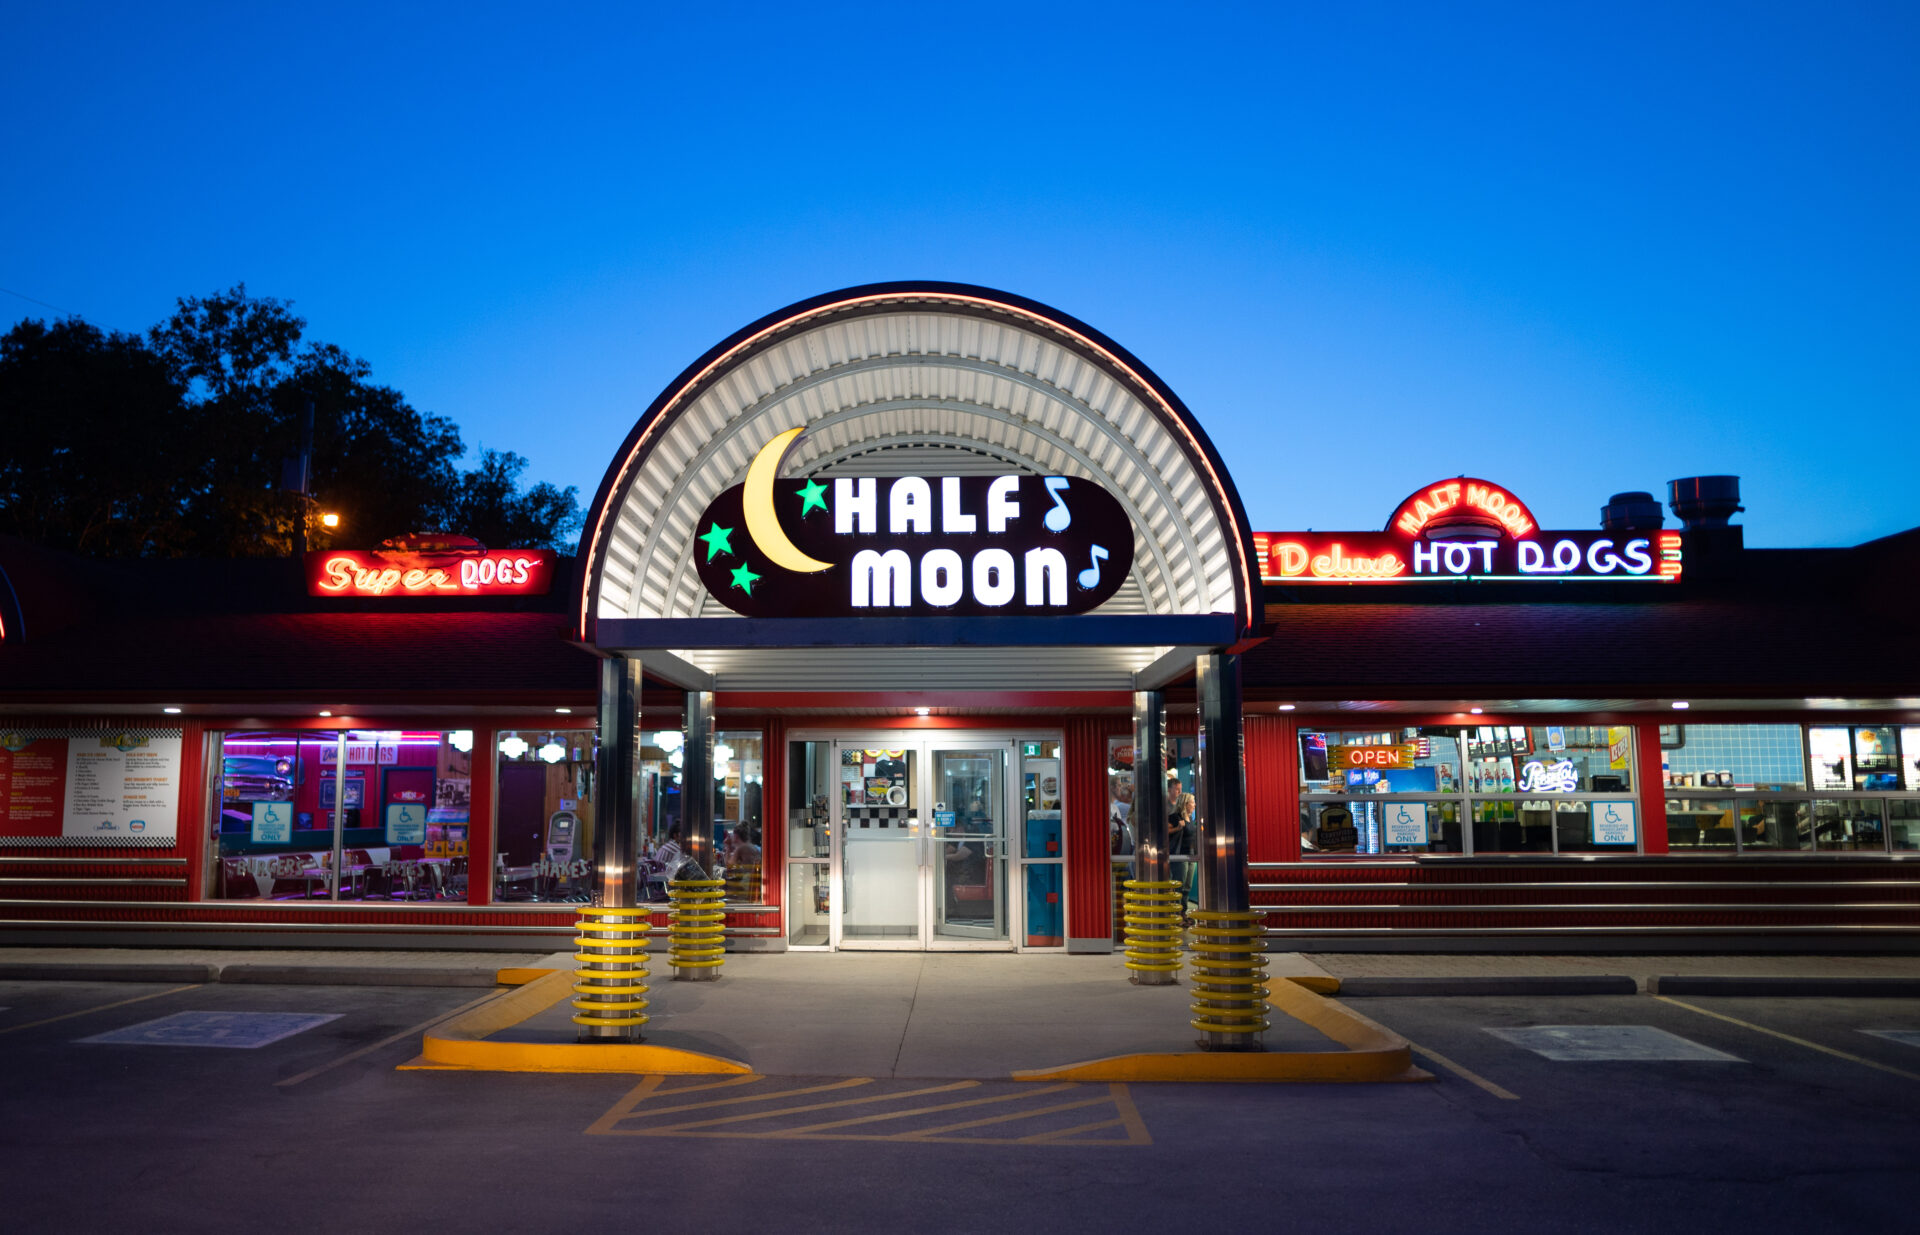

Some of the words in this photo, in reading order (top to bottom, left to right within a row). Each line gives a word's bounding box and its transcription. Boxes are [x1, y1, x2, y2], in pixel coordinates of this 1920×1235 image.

[835, 475, 1020, 533] HALF
[1397, 483, 1461, 537] HALF
[1466, 483, 1535, 539] MOON
[1271, 542, 1406, 578] Deluxe
[1413, 541, 1499, 574] HOT
[1517, 540, 1653, 576] DOGS
[318, 557, 458, 595] Super
[460, 558, 544, 589] DOGS
[851, 546, 1068, 607] MOON
[349, 746, 366, 762] HOT
[1350, 750, 1400, 764] OPEN
[260, 833, 281, 841] ONLY
[1395, 835, 1418, 843] ONLY
[1603, 834, 1626, 842] ONLY
[236, 858, 305, 878] BURGERS
[381, 859, 425, 878] FRIES
[531, 859, 591, 880] SHAKES
